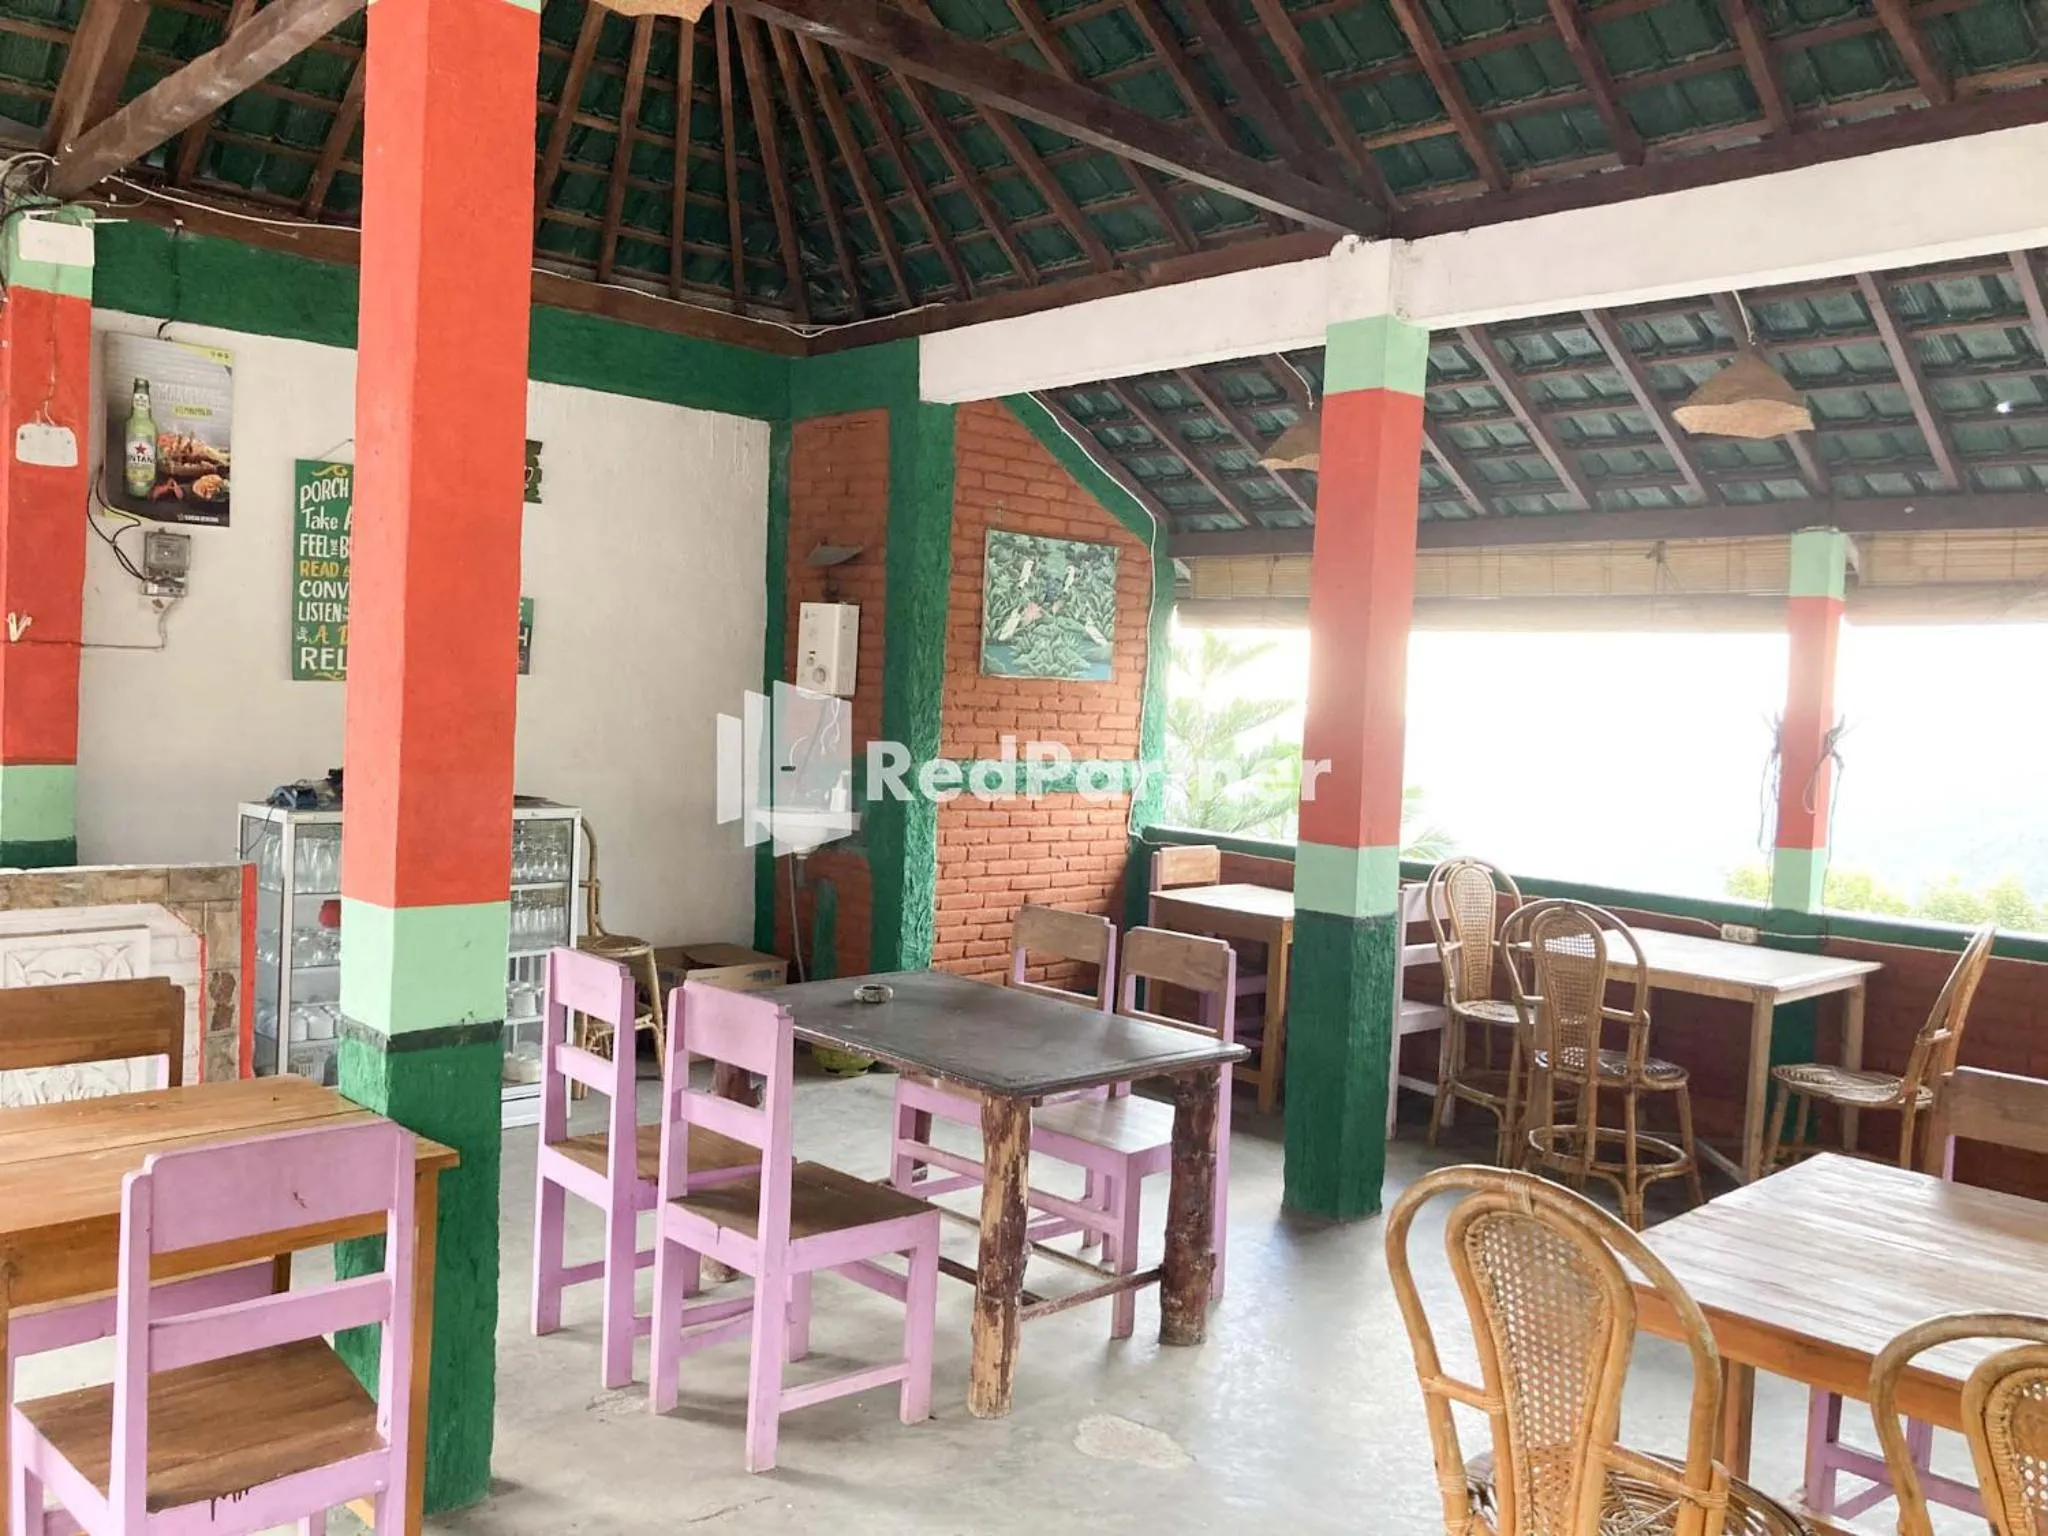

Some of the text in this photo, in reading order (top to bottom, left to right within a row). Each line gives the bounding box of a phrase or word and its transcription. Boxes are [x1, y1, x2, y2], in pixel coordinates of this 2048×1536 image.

[300, 477, 349, 509] PORCH
[301, 505, 338, 531] Take
[300, 533, 331, 558] FEEL
[300, 560, 340, 578] READ
[299, 580, 349, 600] CONV
[298, 601, 342, 622] LISTEN
[300, 646, 347, 670] REL
